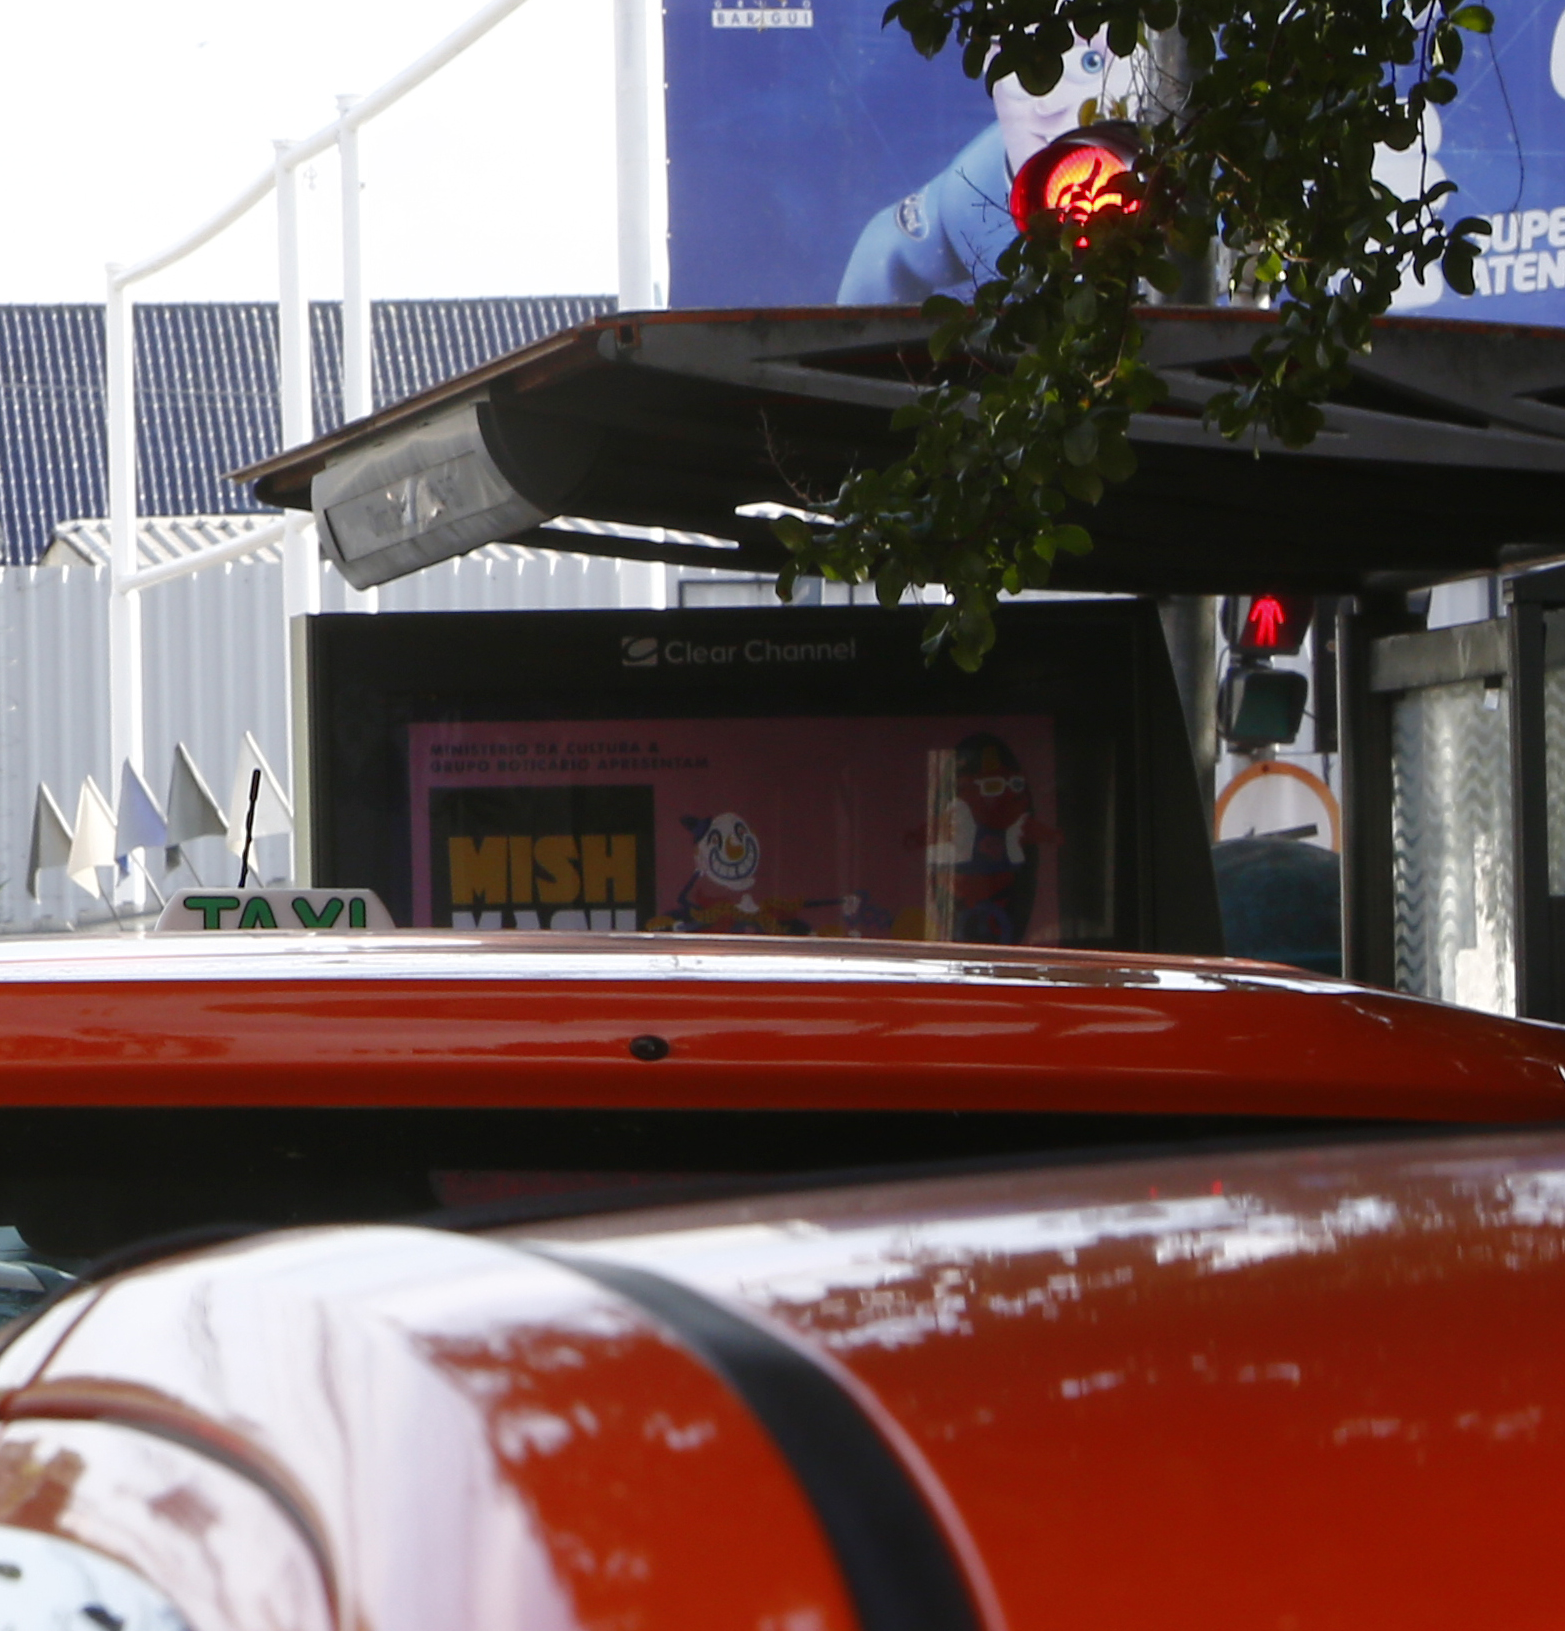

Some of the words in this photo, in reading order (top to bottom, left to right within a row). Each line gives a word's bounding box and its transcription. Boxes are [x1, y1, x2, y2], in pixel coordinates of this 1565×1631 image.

[665, 641, 737, 663] Clear
[744, 637, 856, 662] Channel
[431, 759, 490, 773] GRUPO
[449, 834, 637, 904] MISH
